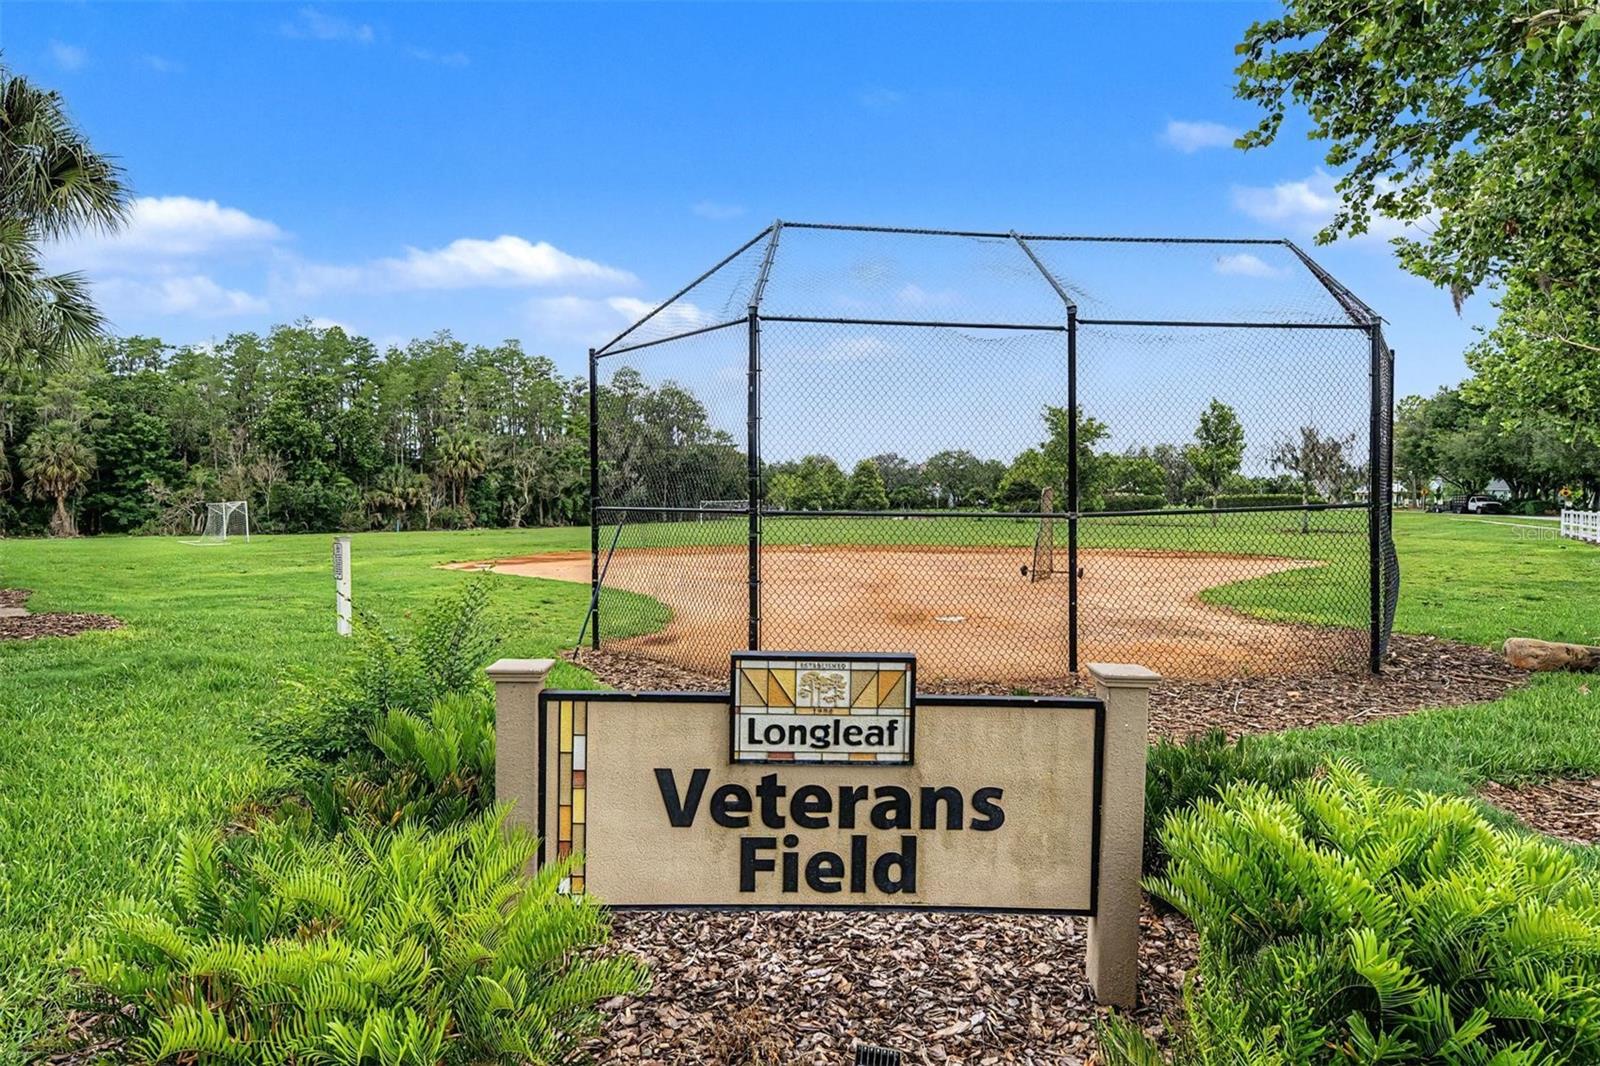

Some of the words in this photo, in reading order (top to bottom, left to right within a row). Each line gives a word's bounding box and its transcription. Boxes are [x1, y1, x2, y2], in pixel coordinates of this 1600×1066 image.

[748, 717, 899, 749] Longleaf
[653, 768, 1006, 831] Veterans
[739, 834, 918, 894] Field
